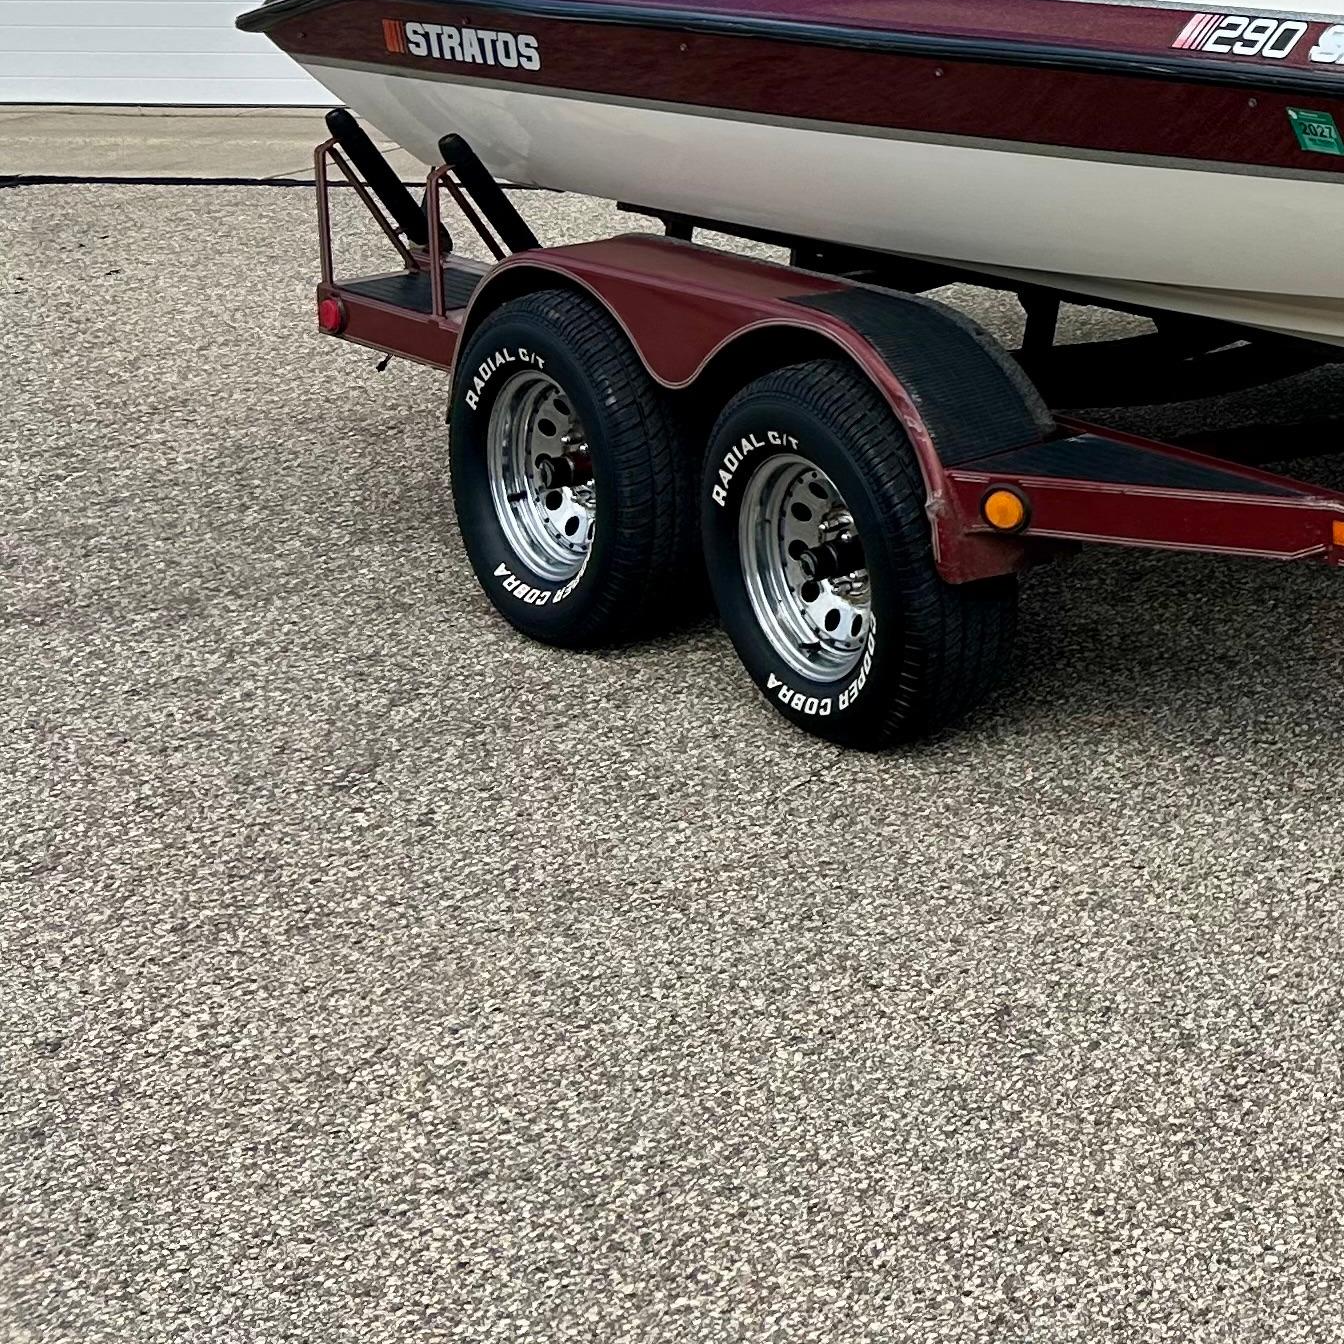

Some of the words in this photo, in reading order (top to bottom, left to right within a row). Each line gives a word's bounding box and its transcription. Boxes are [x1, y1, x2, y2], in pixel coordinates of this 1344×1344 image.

[405, 22, 541, 71] STRATOS
[1202, 15, 1309, 59] 290
[1299, 122, 1334, 139] 2027
[465, 347, 516, 411] RADIAL
[711, 433, 766, 507] RADIAL
[493, 562, 551, 606] COBRA
[766, 672, 832, 716] COBRA
